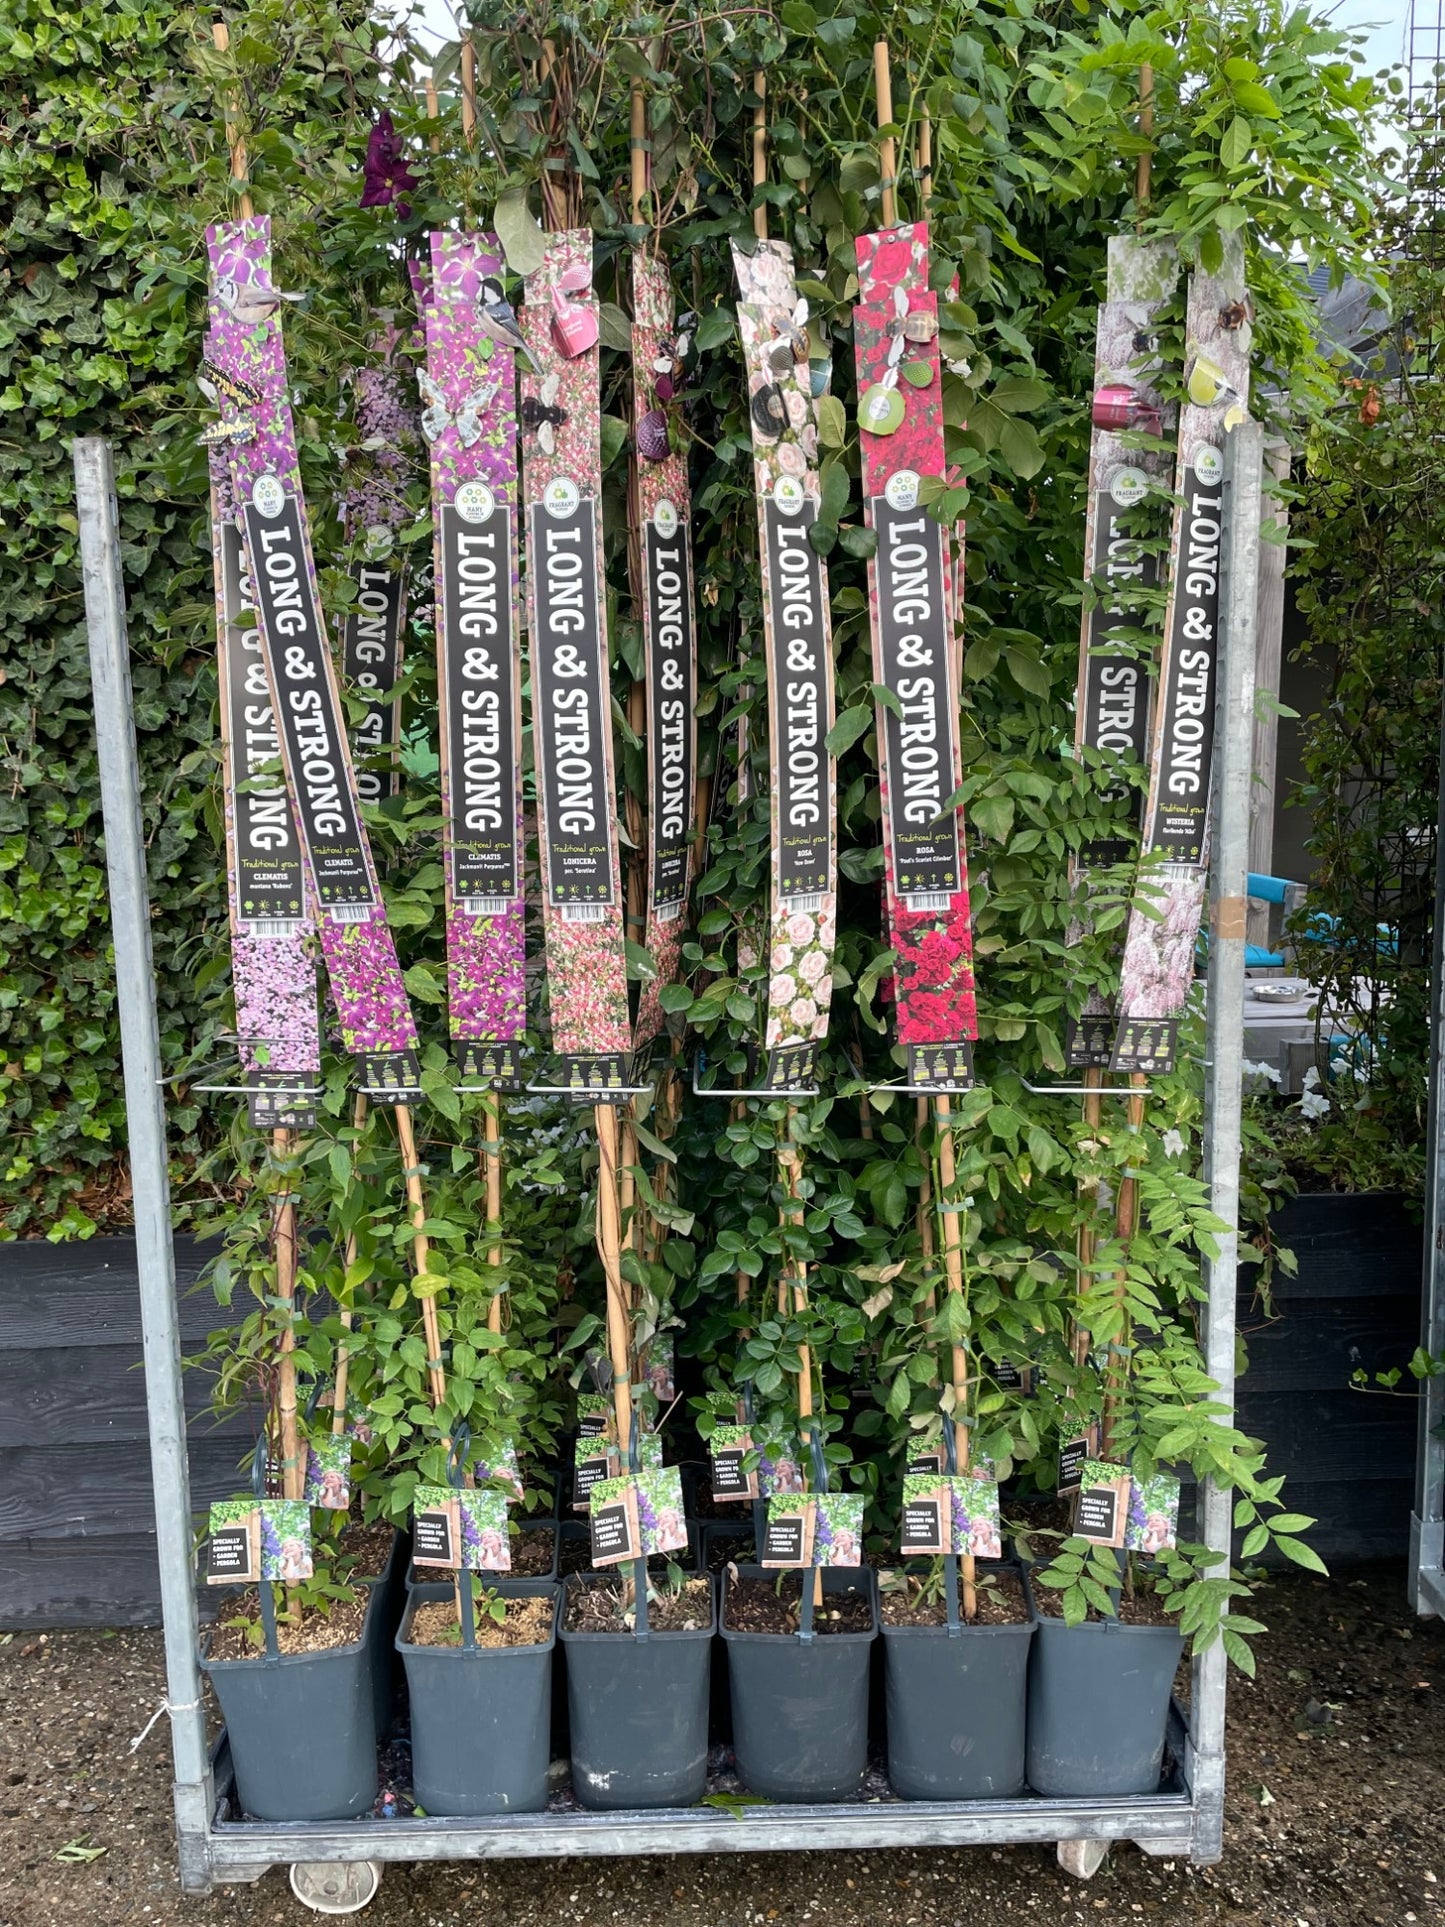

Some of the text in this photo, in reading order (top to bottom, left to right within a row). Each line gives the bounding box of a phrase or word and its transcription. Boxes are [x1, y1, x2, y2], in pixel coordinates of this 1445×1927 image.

[889, 518, 931, 625] LONG
[457, 532, 498, 638] LONG
[355, 568, 391, 664] LONG
[1168, 492, 1222, 796] LONG & STRONG
[896, 634, 934, 668] &
[461, 647, 500, 680] &
[260, 526, 347, 837] LONG & STRONG
[546, 527, 596, 835] LONG & STRONG
[777, 524, 820, 827] LONG & STRONG
[656, 548, 685, 839] LONG & STRONG
[896, 677, 942, 824] STRONG
[461, 690, 502, 832] STRONG
[1159, 802, 1189, 813] Traditional
[1166, 818, 1195, 826] WISTERIA
[782, 834, 811, 846] Traditional
[896, 831, 952, 844] Traditional grown
[311, 844, 360, 857] Traditional grown
[494, 843, 511, 851] grown
[552, 843, 606, 856] Traditional grown
[916, 846, 935, 854] ROSA
[797, 849, 813, 858] ROSA
[241, 858, 299, 870] Traditional grown
[324, 859, 353, 867] CLEMATIS
[578, 1468, 602, 1476] SPECIALLY
[1082, 1498, 1108, 1506] SPECIALLY
[595, 1516, 619, 1526] SPECIALLY
[1084, 1512, 1104, 1520] GARDEN
[417, 1521, 442, 1529] SPECIALLY
[595, 1522, 624, 1533] GROWN FOR
[1083, 1520, 1106, 1528] PERGOLA
[599, 1531, 618, 1540] GARDEN
[600, 1538, 621, 1547] PERGOLA
